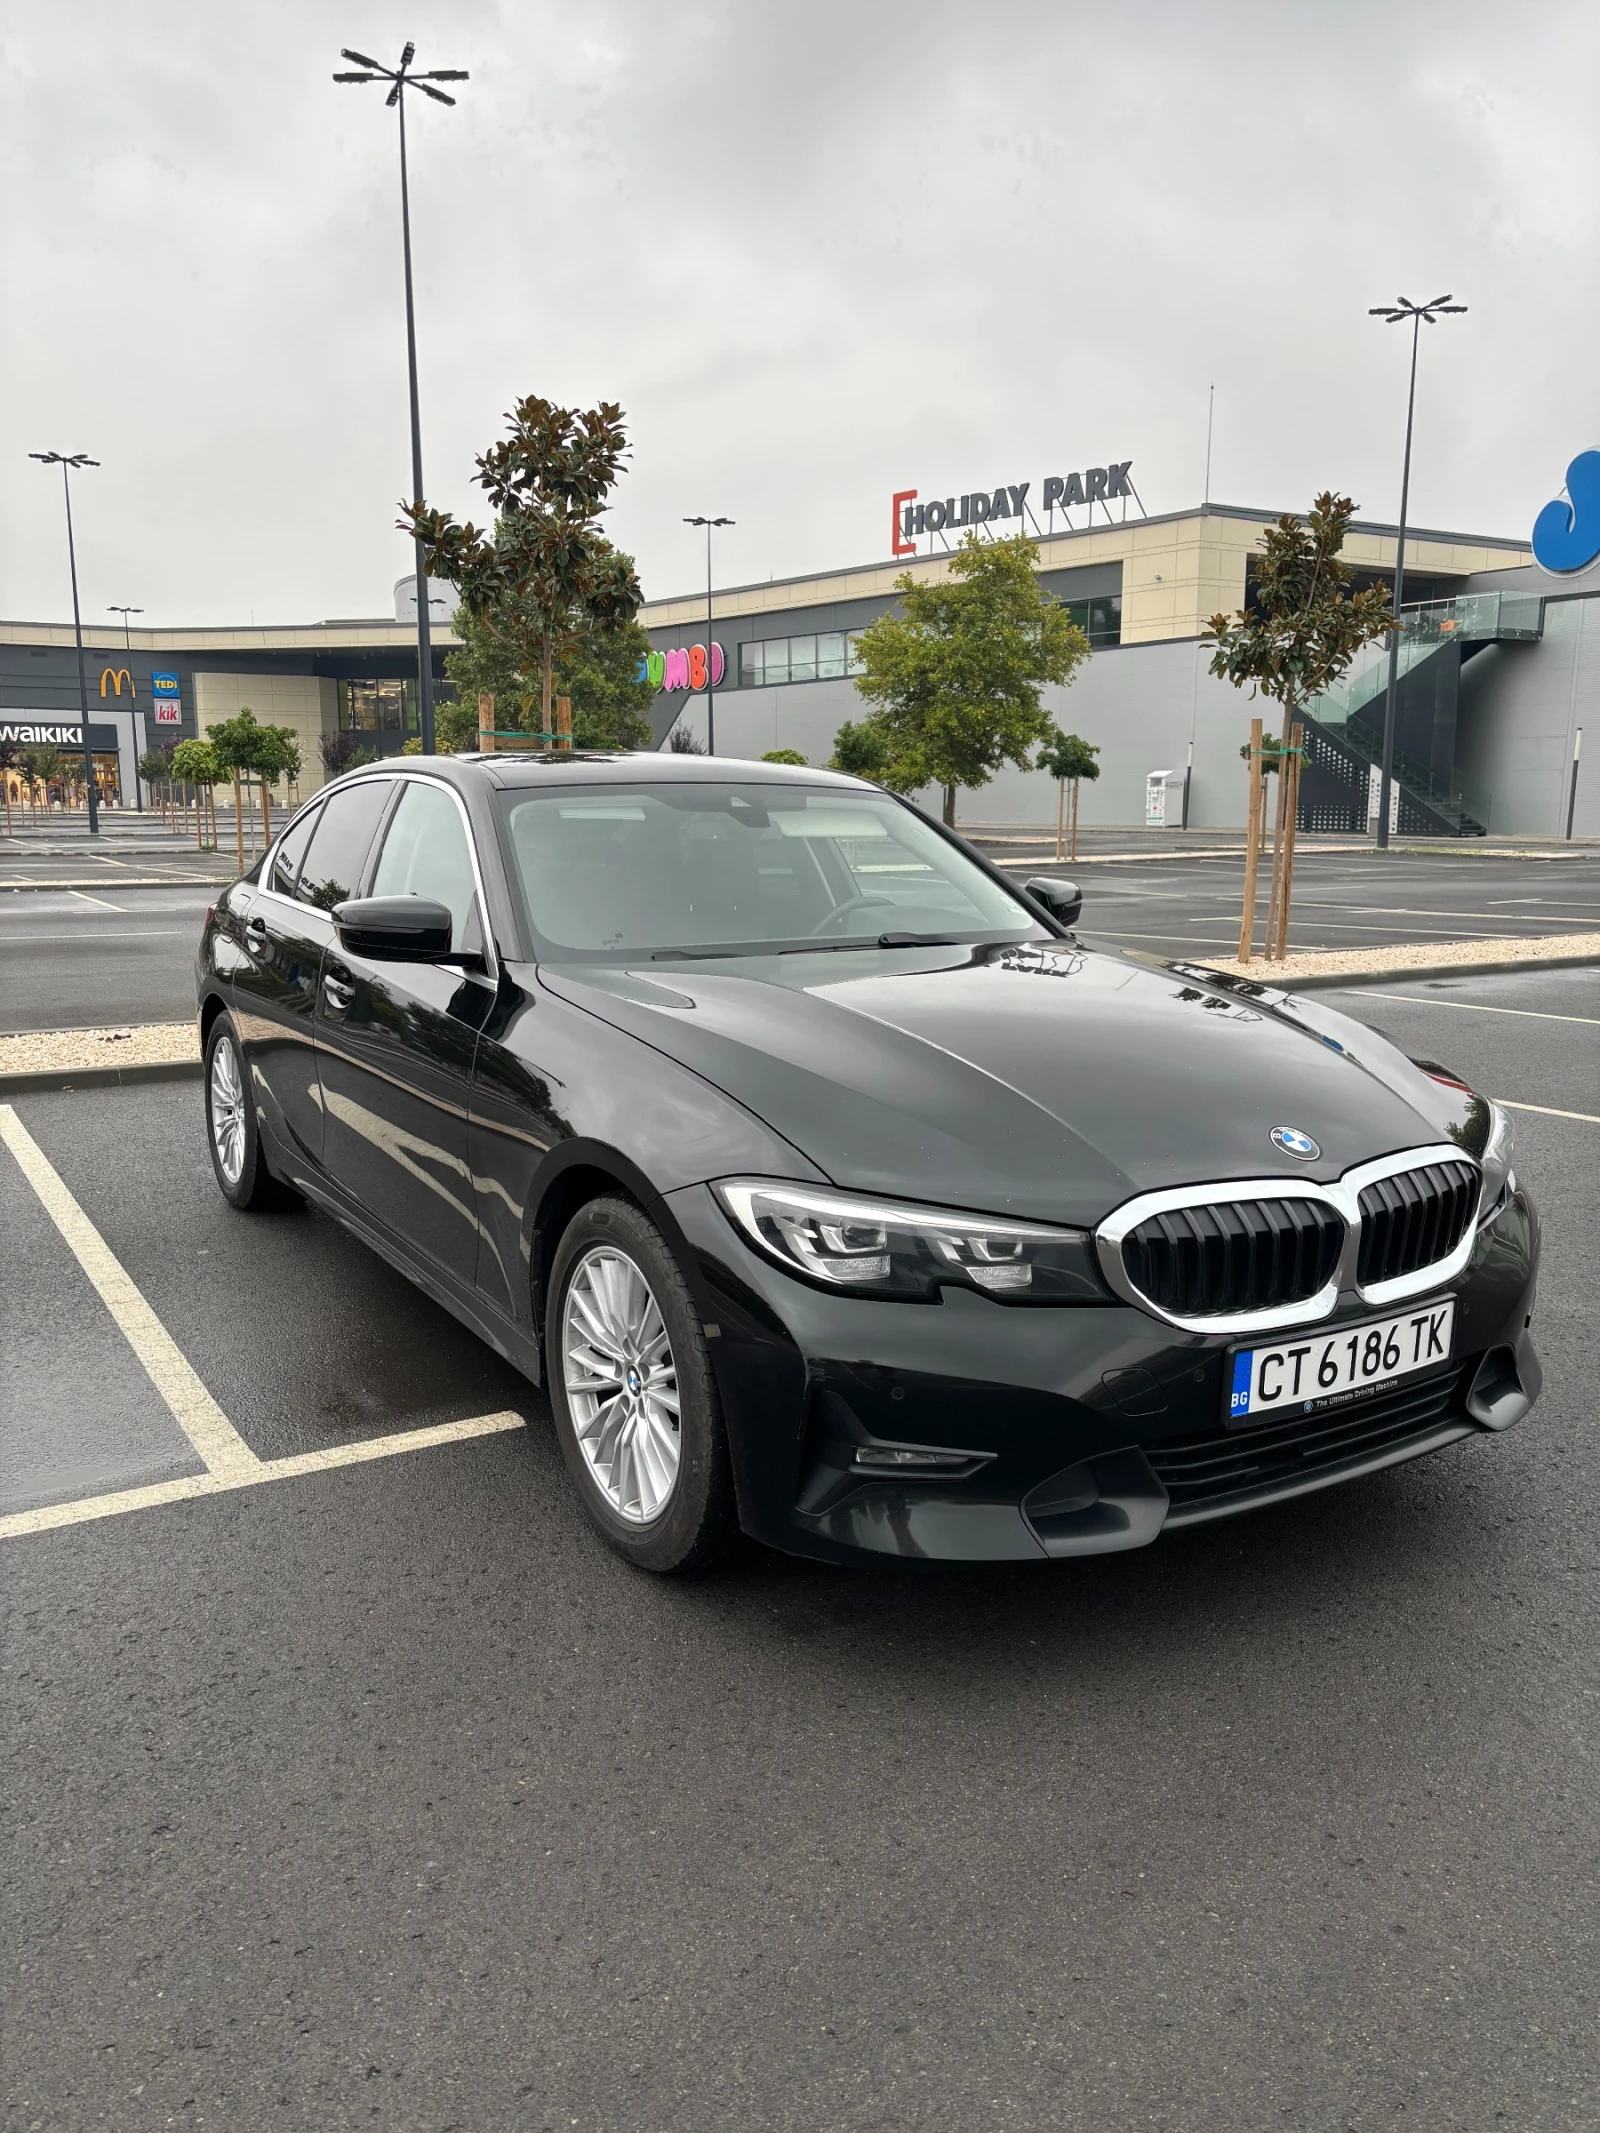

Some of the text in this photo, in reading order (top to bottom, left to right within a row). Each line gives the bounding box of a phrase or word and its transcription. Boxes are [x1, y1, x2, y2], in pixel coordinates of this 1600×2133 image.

[905, 461, 1133, 537] HOLIDAY PARK
[1258, 1310, 1448, 1402] CT 6186 TK
[1231, 1391, 1248, 1408] BG
[1316, 1400, 1328, 1408] The
[1329, 1392, 1354, 1405] Ultimate
[1354, 1385, 1375, 1398] Driving
[1375, 1379, 1398, 1392] Machine
